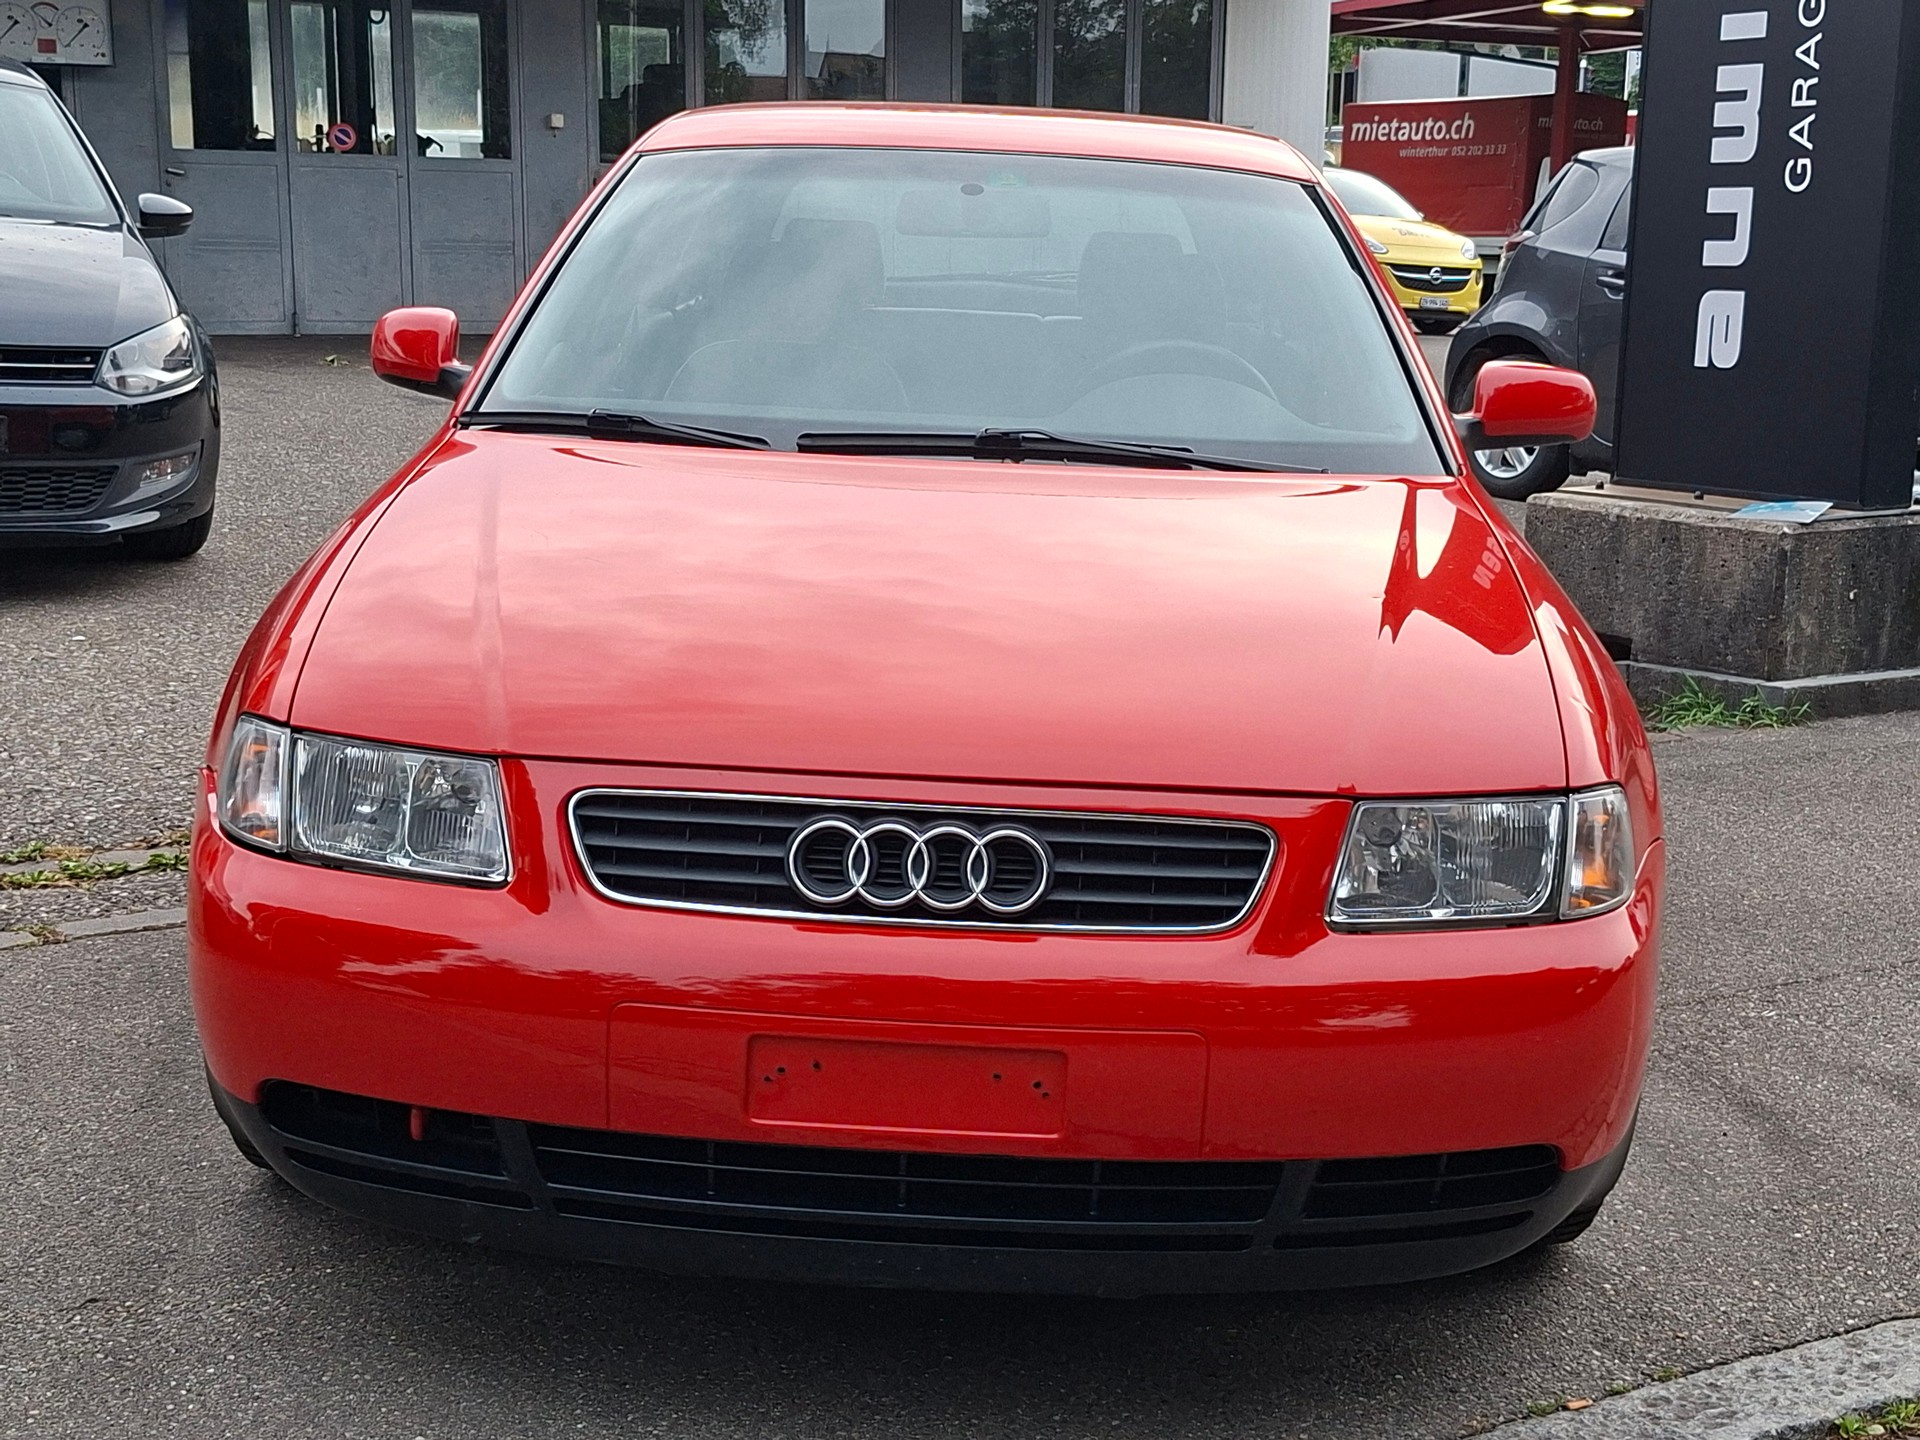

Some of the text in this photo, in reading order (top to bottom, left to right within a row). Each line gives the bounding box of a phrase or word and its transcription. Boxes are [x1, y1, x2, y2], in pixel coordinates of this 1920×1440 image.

[1350, 112, 1475, 142] mietauto.ch
[1400, 144, 1507, 157] winterthur 052 202 33 33
